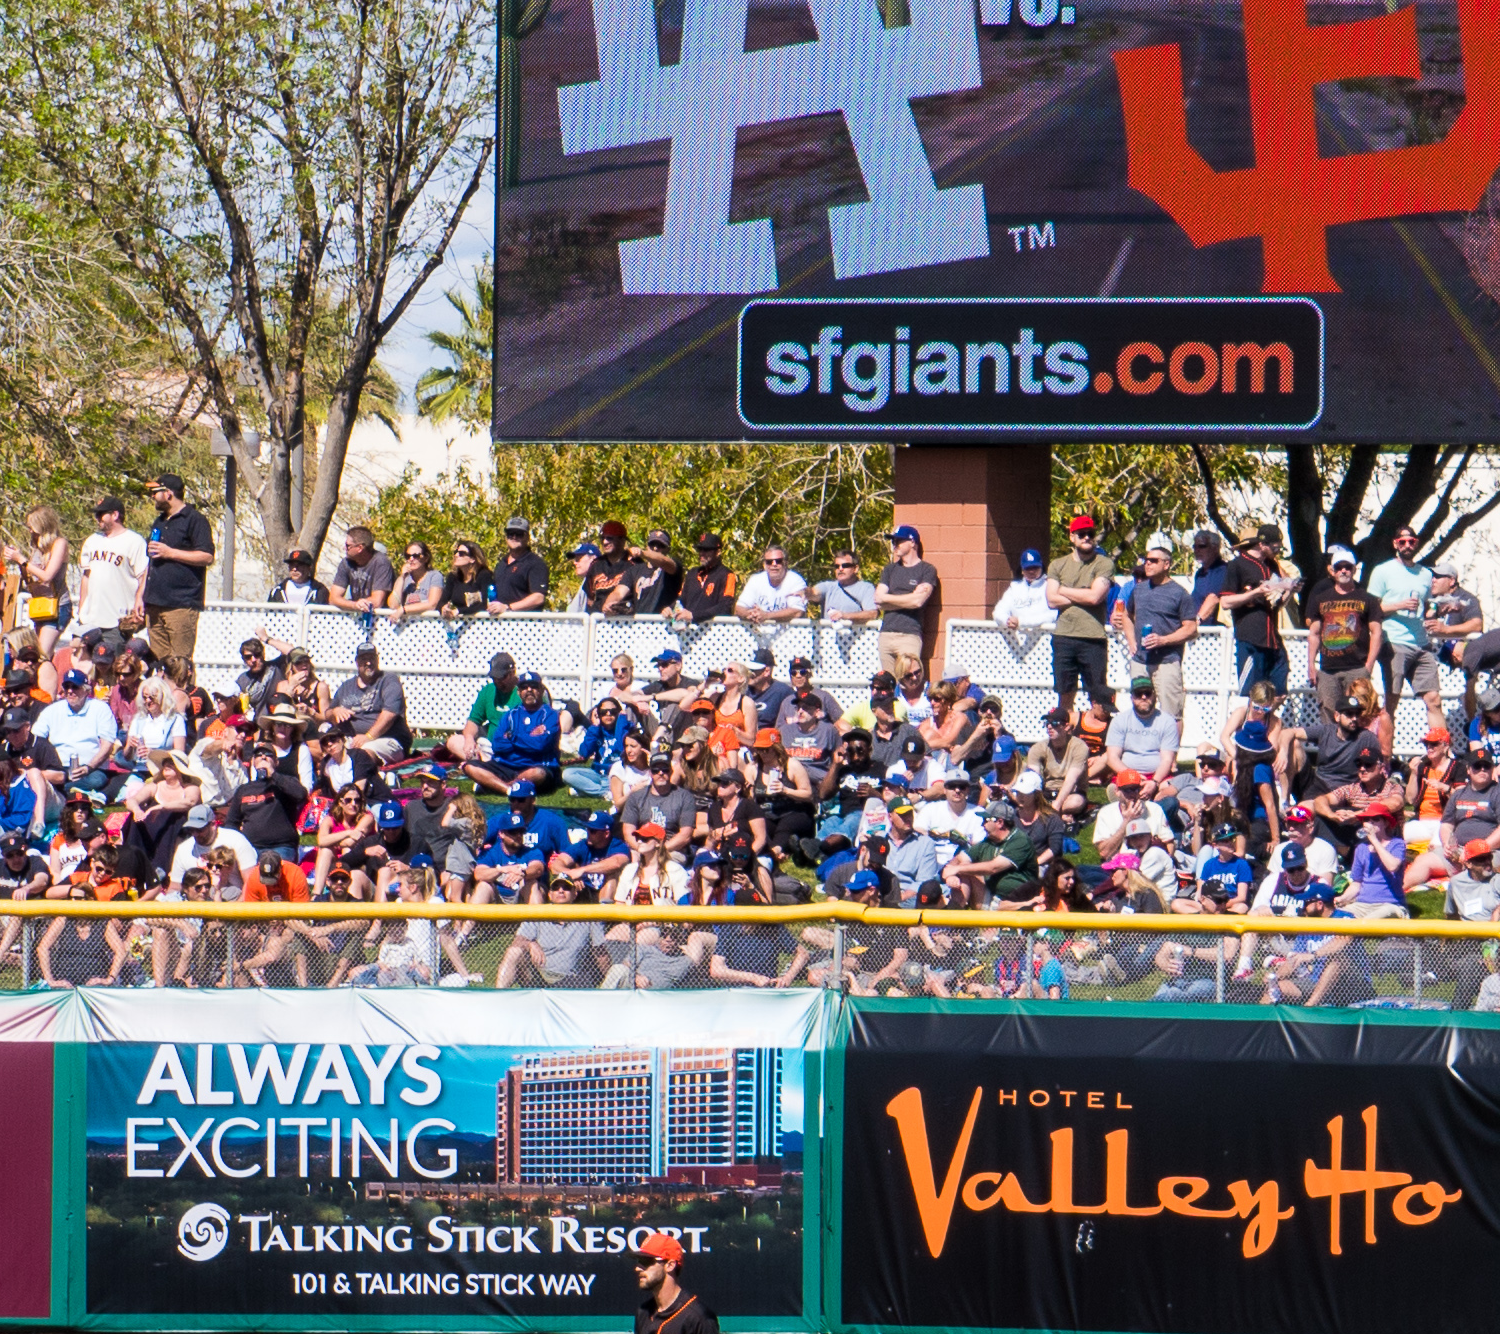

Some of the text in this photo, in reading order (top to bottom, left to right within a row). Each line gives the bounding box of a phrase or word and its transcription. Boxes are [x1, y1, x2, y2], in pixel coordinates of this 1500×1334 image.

[764, 323, 1297, 429] sfgiants.com
[137, 1043, 442, 1107] ALWAYS
[999, 1089, 1133, 1110] HOTEL
[126, 1117, 459, 1179] EXCITING
[886, 1085, 1462, 1259] Valley Ho
[292, 1273, 597, 1297] 101 & TALKING STICK WAY
